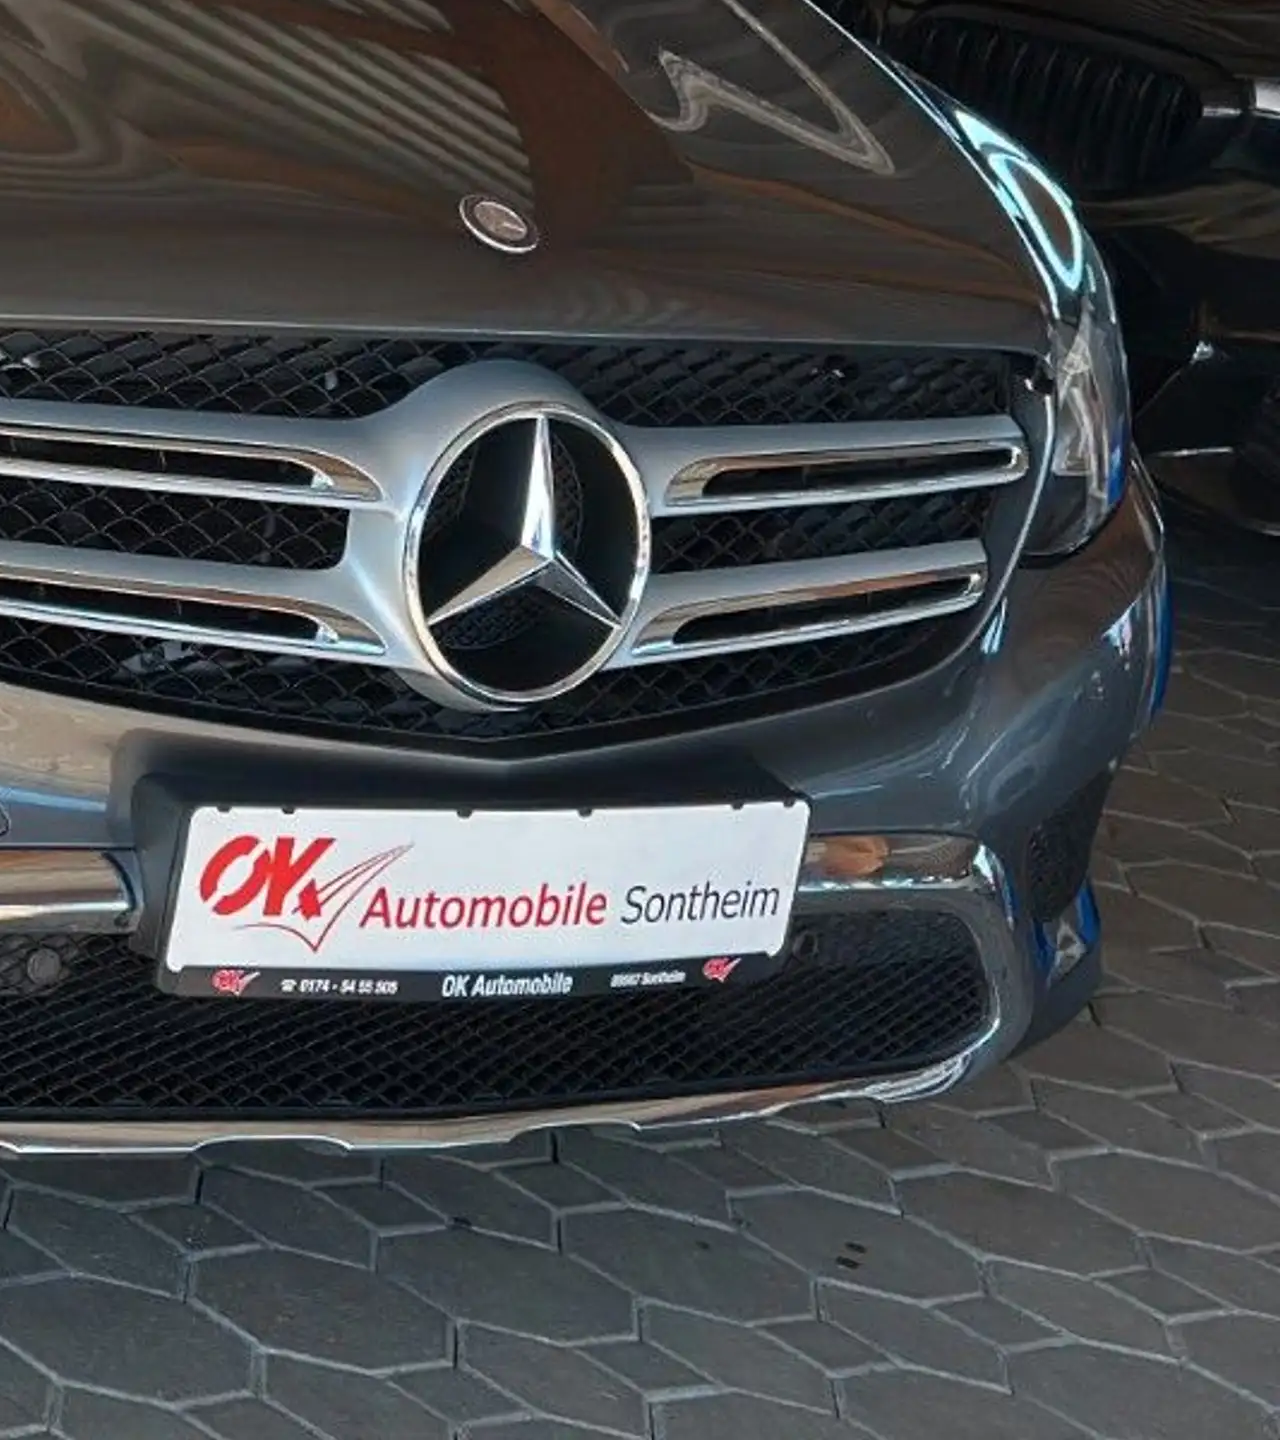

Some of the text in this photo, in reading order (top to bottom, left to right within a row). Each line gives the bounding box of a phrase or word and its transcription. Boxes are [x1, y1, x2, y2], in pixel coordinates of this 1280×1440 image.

[199, 834, 781, 928] OK Automobile Sontheim
[441, 972, 573, 997] OK Automobile
